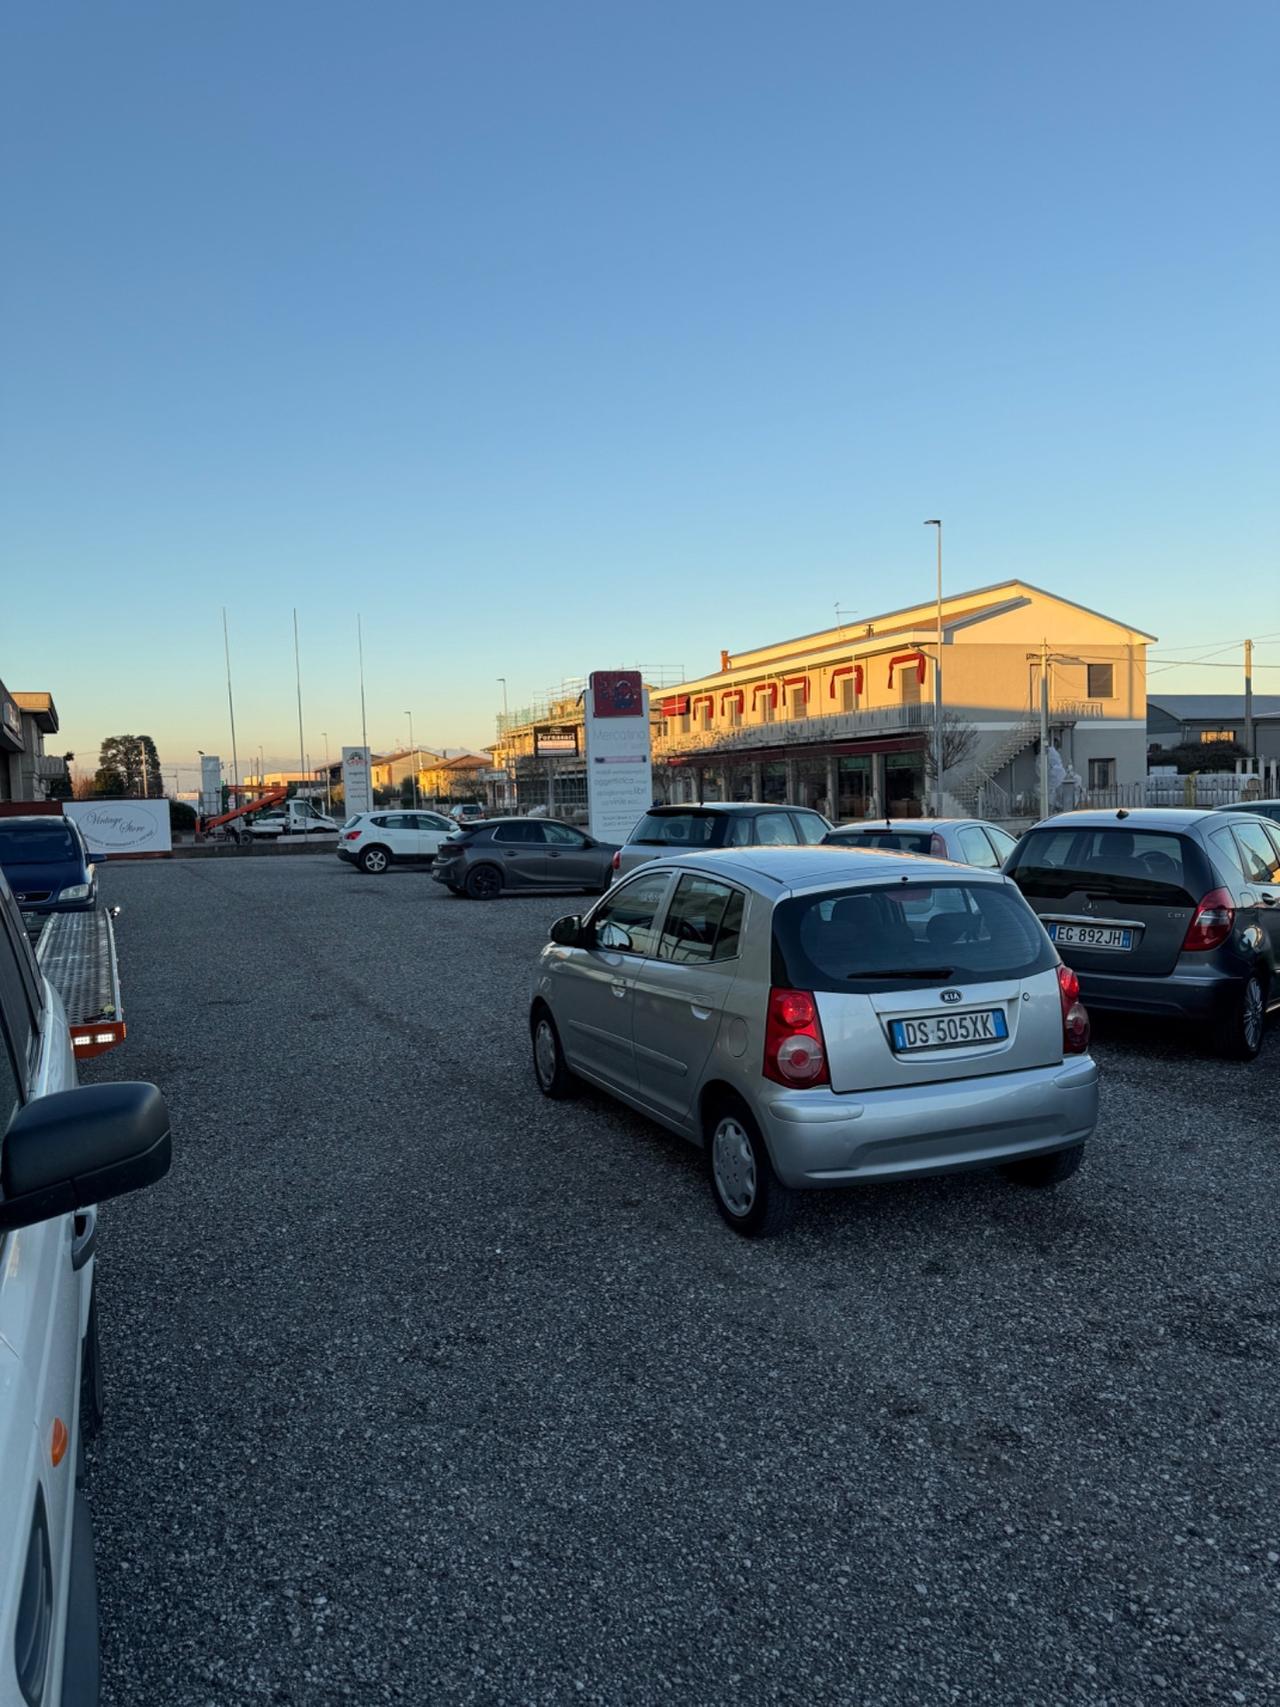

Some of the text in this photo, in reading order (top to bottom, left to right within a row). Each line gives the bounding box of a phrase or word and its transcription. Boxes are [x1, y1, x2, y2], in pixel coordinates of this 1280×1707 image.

[594, 728, 646, 741] Mercatino
[87, 811, 123, 829] Vintage
[119, 820, 145, 834] Store
[1057, 927, 1121, 947] EG 892JH
[943, 992, 960, 1001] KIA
[905, 1021, 929, 1046] DS
[936, 1013, 994, 1043] 505XK
